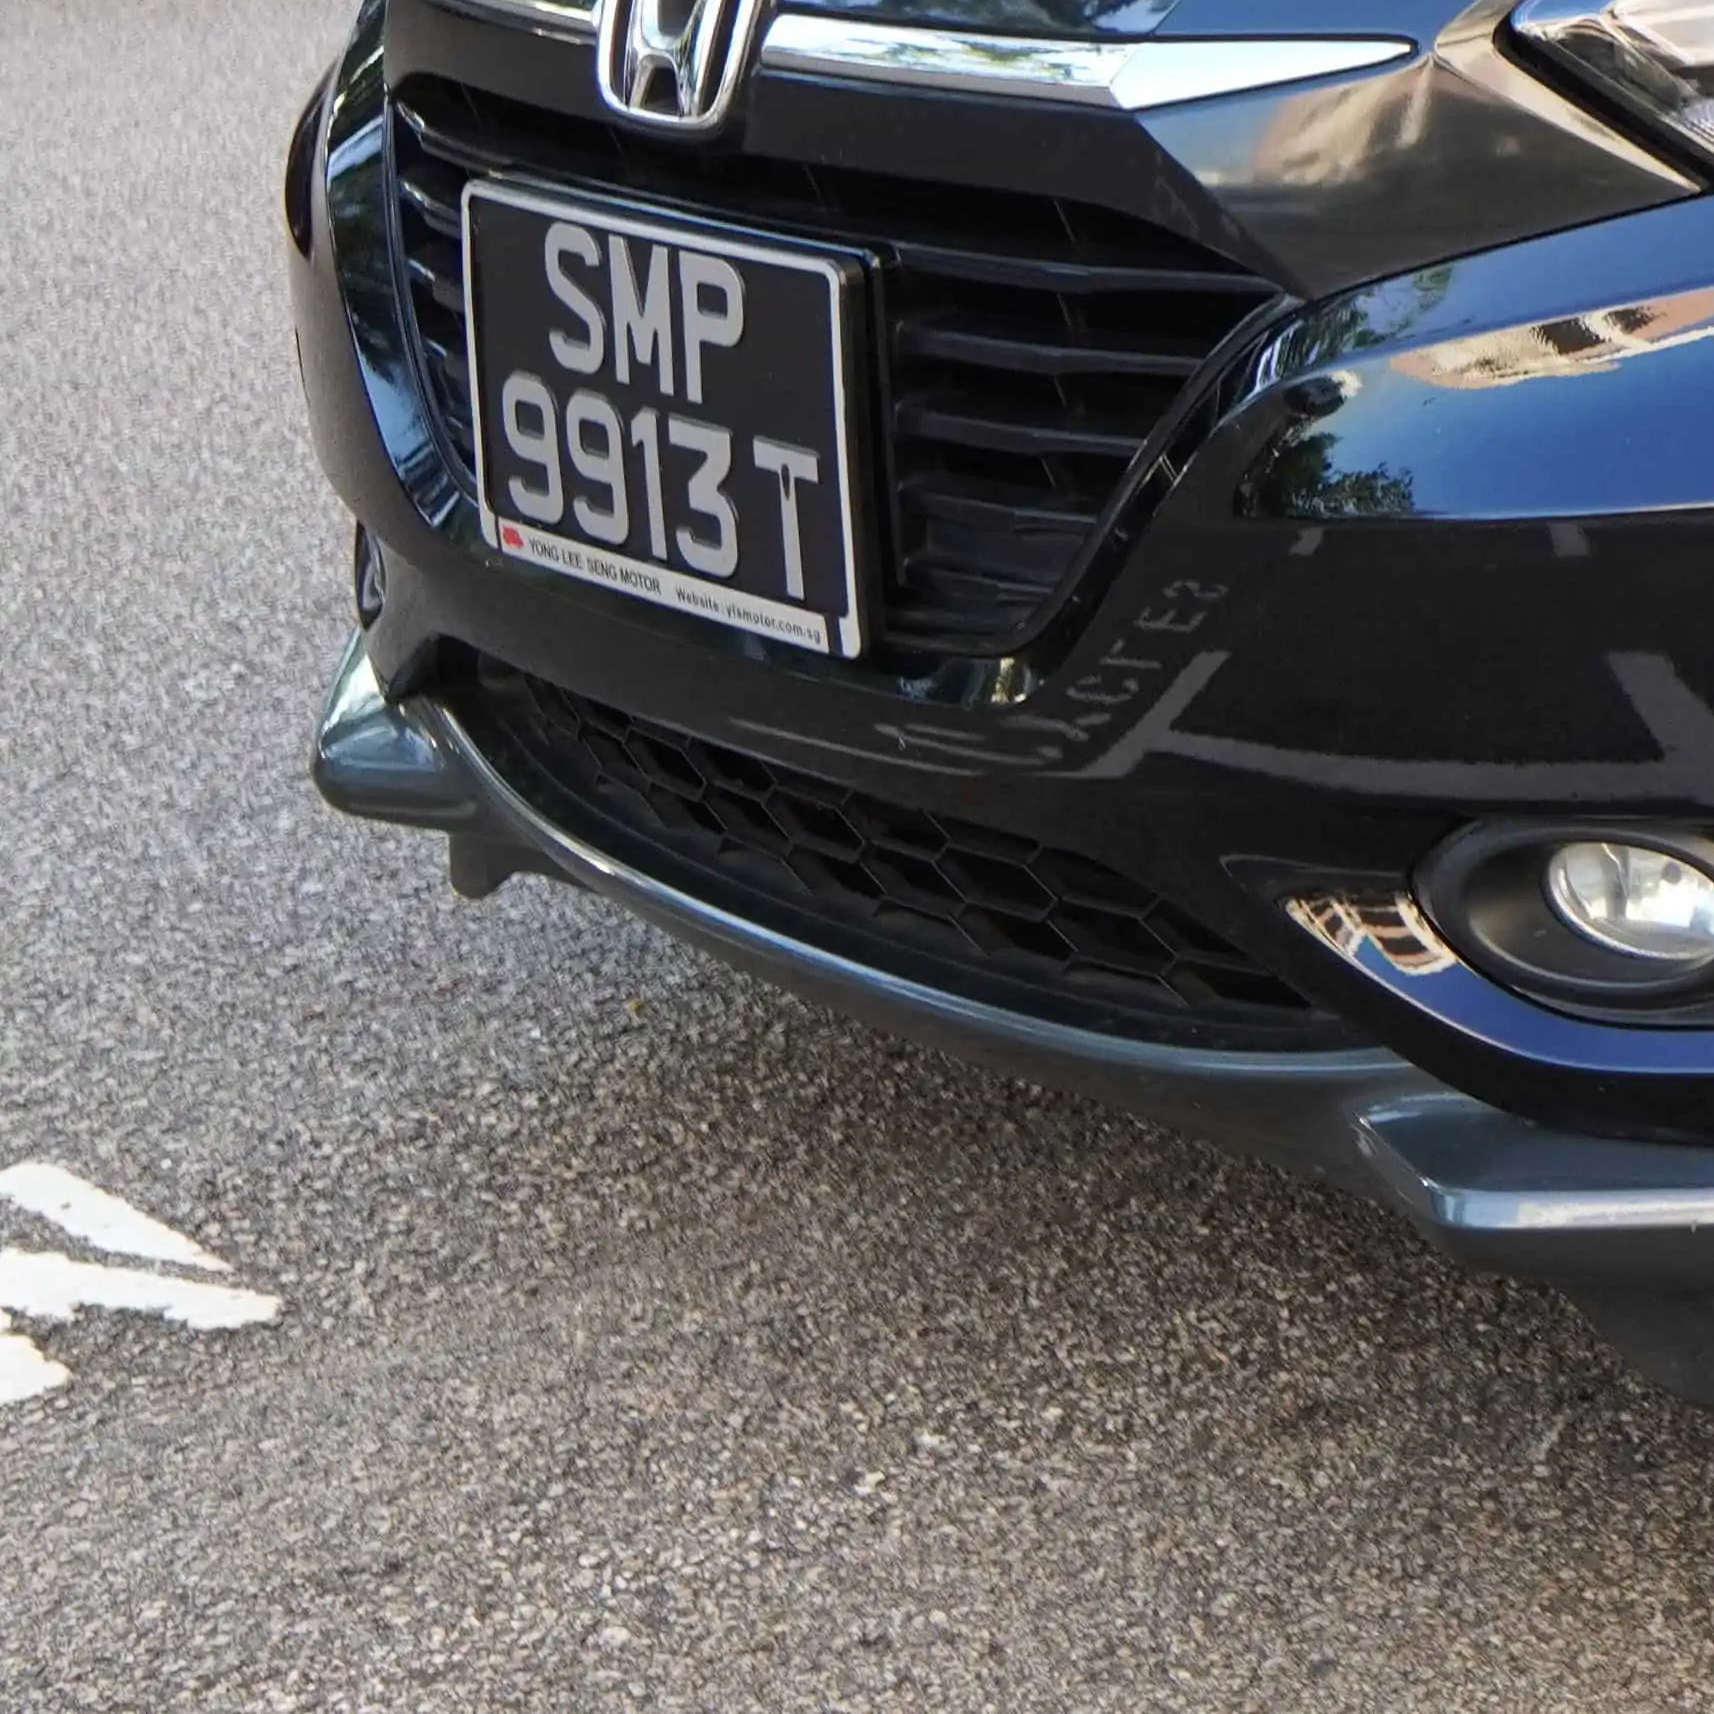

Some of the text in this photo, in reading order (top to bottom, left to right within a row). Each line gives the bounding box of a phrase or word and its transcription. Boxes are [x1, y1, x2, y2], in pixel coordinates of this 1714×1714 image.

[544, 221, 746, 404] SMP
[528, 537, 560, 562] YONG
[562, 549, 583, 570] LEE
[586, 557, 618, 582] SENG
[620, 570, 662, 596] MOTOR
